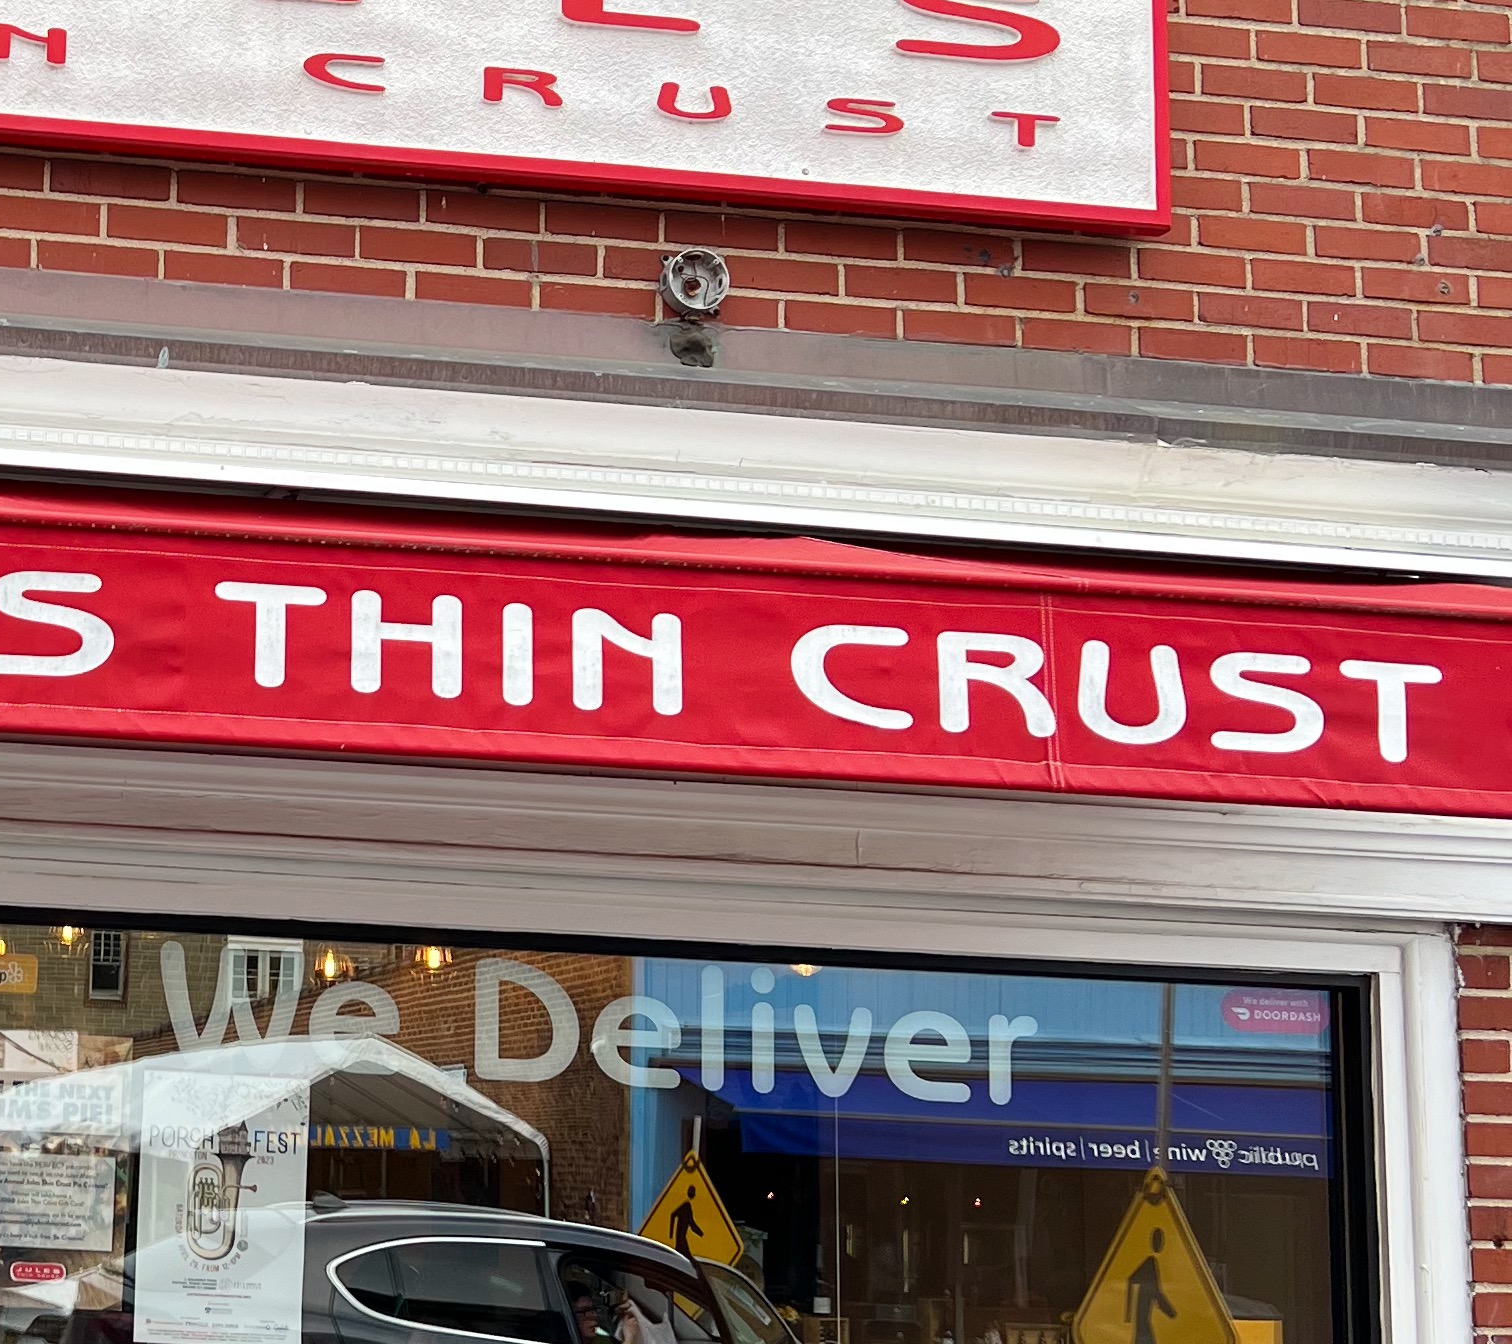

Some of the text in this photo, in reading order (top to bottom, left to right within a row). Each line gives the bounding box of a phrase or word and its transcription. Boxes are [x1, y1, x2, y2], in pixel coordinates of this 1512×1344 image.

[303, 51, 1061, 149] CRUST
[214, 581, 683, 716] THIN
[791, 624, 1443, 763] CRUST
[1242, 996, 1258, 1005] We
[1259, 997, 1288, 1006] deliver
[159, 940, 1039, 1106] We Deliver
[1254, 1009, 1321, 1022] DOORDASH
[12, 1080, 51, 1098] THE
[58, 1083, 114, 1102] NEXT
[62, 1102, 114, 1125] PIE!
[149, 1124, 301, 1155] PORCH FEST
